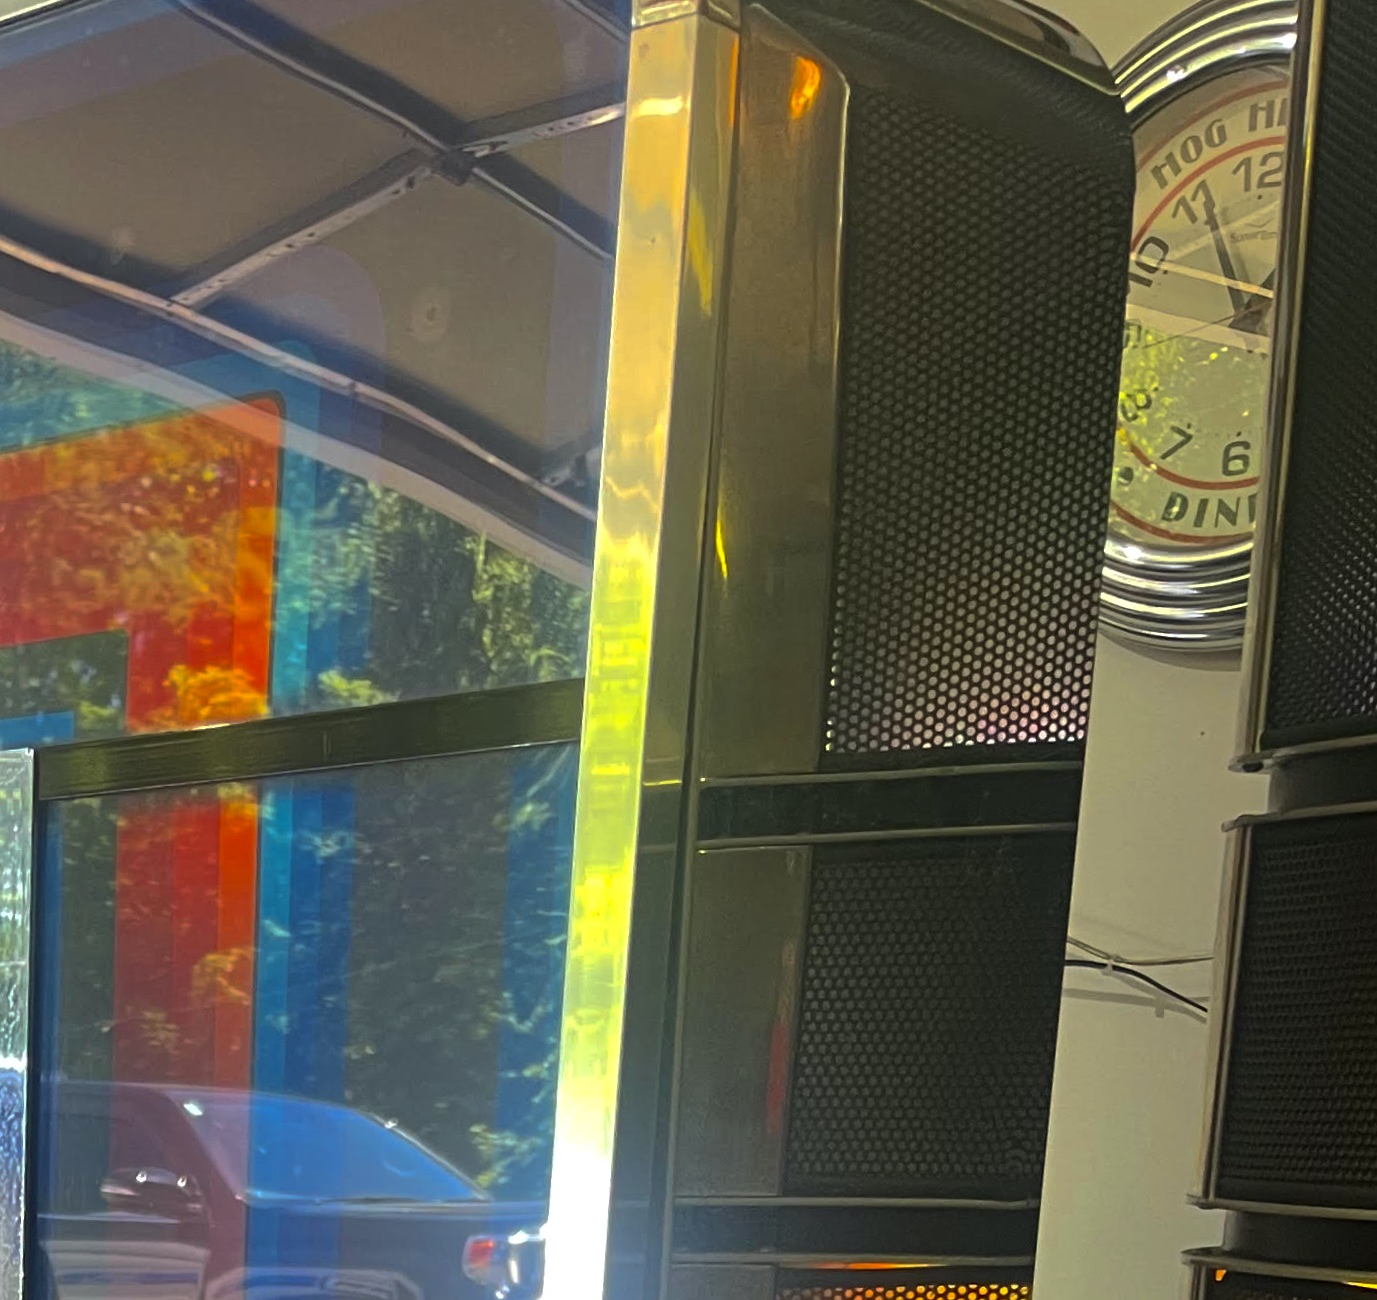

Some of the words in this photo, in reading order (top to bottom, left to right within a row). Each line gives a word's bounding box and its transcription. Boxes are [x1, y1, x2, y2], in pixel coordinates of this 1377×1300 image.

[1151, 119, 1227, 189] HOG
[1231, 150, 1284, 192] 12
[1172, 180, 1216, 226] 11
[1128, 236, 1169, 287] 10
[1160, 426, 1193, 460] 7
[1223, 441, 1251, 476] 6
